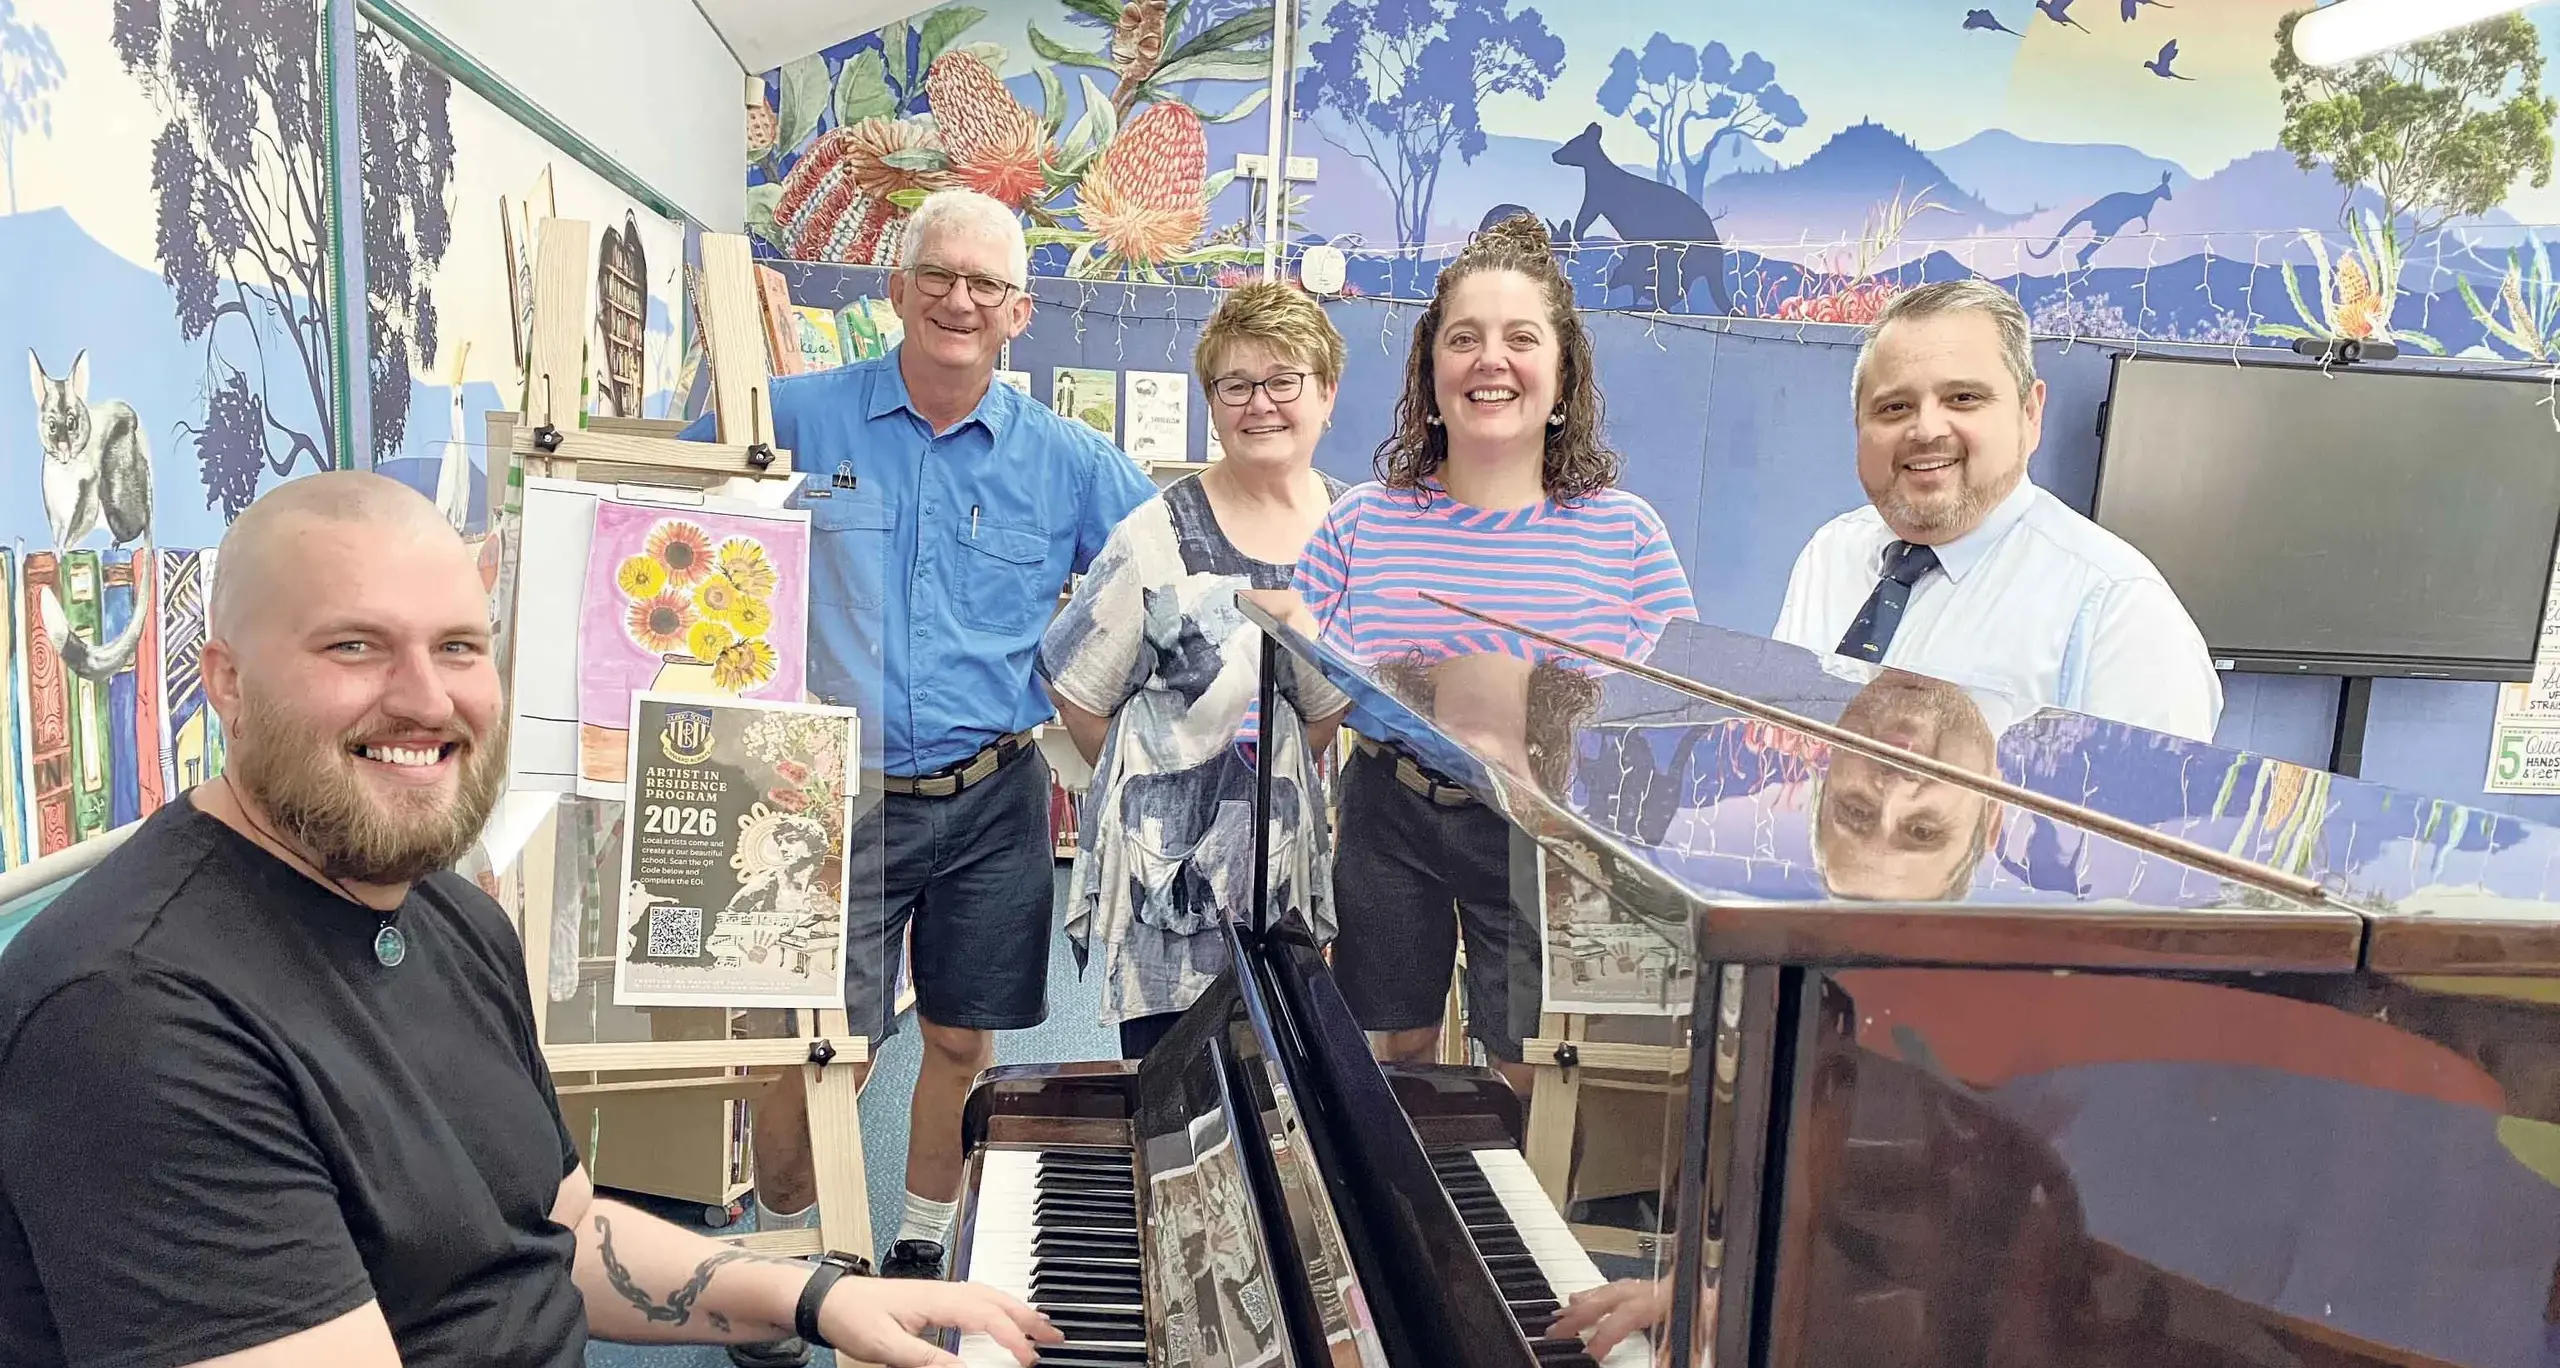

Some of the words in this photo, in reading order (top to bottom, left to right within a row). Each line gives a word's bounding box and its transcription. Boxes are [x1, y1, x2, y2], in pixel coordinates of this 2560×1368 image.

[2499, 735, 2524, 780] 5
[2526, 757, 2560, 767] HANDS
[646, 766, 700, 779] ARTIST
[704, 770, 720, 780] IN
[646, 777, 728, 792] RESIDENCE
[645, 788, 718, 802] PROGRAM
[643, 804, 717, 836] 2026
[642, 836, 663, 845] Local
[664, 838, 687, 846] artists
[710, 839, 724, 847] and
[641, 847, 666, 855] create
[690, 849, 723, 857] beautiful
[669, 857, 688, 865] Scan
[689, 858, 702, 866] the
[702, 859, 714, 867] QR
[641, 866, 661, 874] Code
[662, 867, 684, 875] below
[685, 868, 700, 876] and
[640, 877, 676, 885] complete
